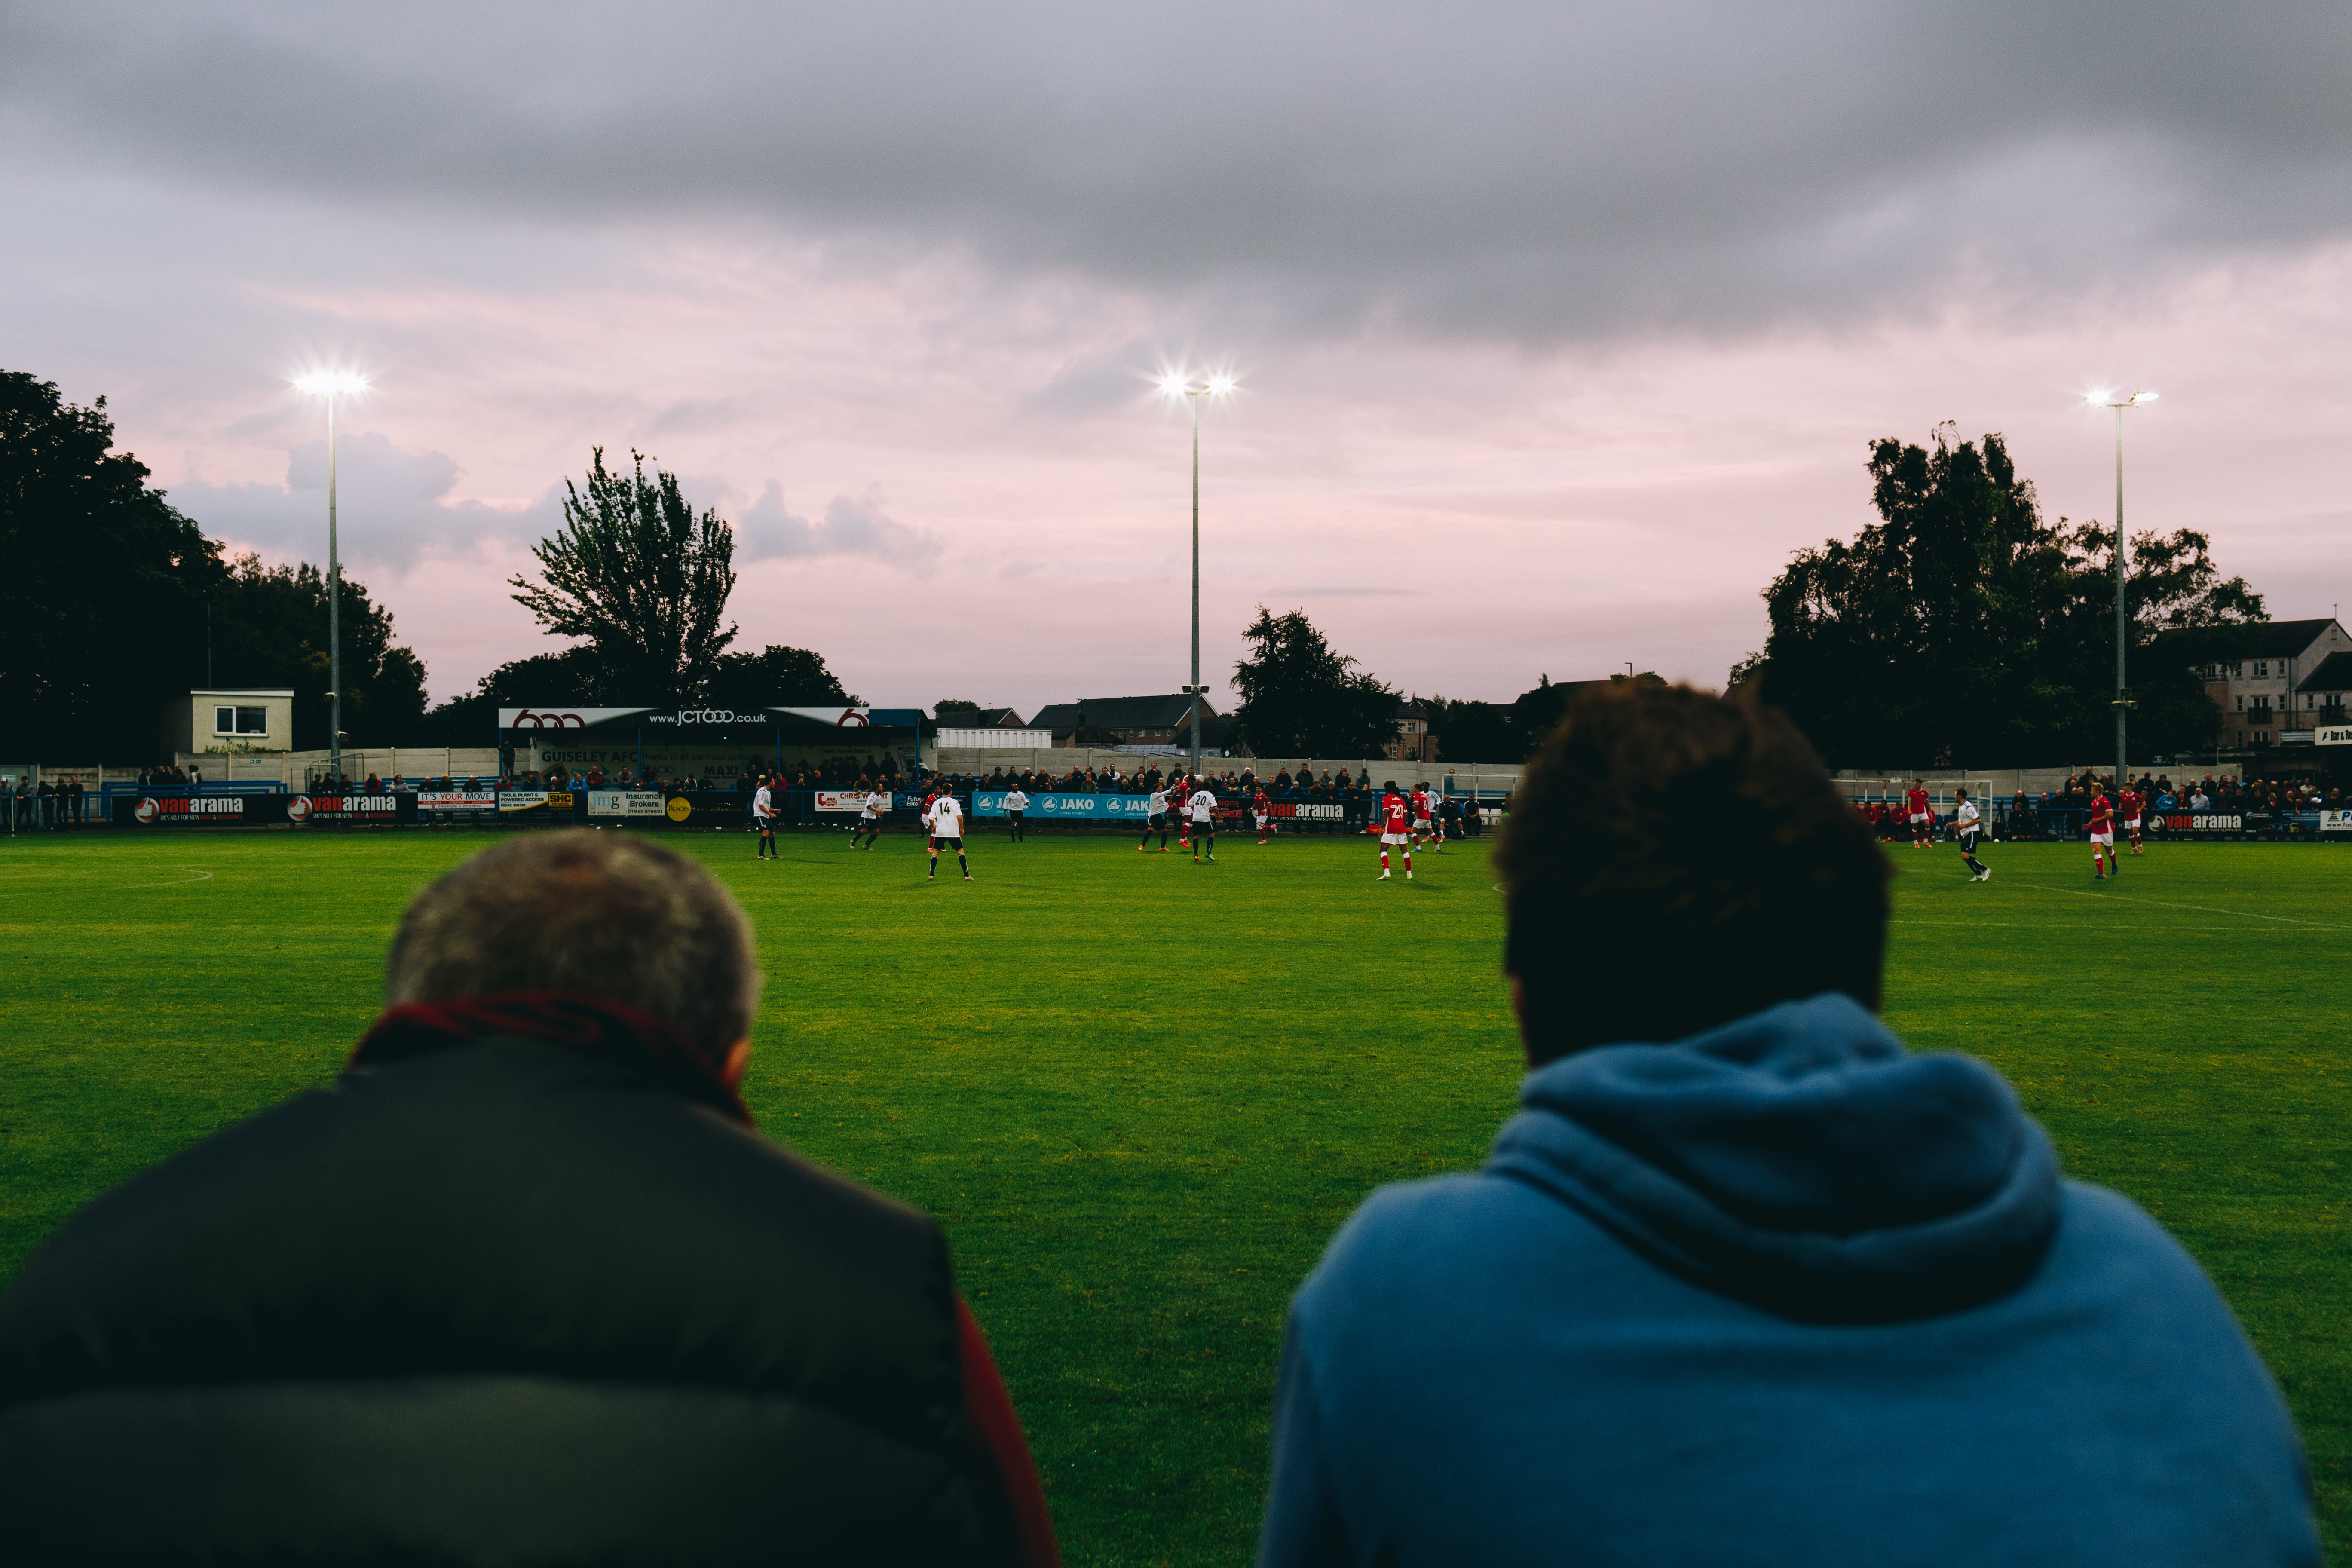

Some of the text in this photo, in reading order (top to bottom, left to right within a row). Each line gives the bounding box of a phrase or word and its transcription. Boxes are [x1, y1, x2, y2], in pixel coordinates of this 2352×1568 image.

[649, 708, 766, 726] www.JCT600.co.uk
[2331, 730, 2340, 741] Bar
[2341, 732, 2345, 741] &
[542, 751, 638, 762] GUISELEY AFC
[680, 752, 689, 760] all
[704, 766, 738, 775] MAXI
[312, 796, 396, 811] vanarama
[550, 794, 571, 802] SHC
[591, 792, 620, 809] jmg
[1195, 795, 1207, 806] 20
[159, 798, 243, 813] vanarama
[939, 802, 950, 815] 14
[1060, 799, 1095, 810] JAKO
[1125, 800, 1150, 811] JAK
[1423, 800, 1427, 810] 6
[1269, 804, 1343, 817] vanarama
[1390, 804, 1403, 819] 20
[2165, 815, 2242, 829] vanarama
